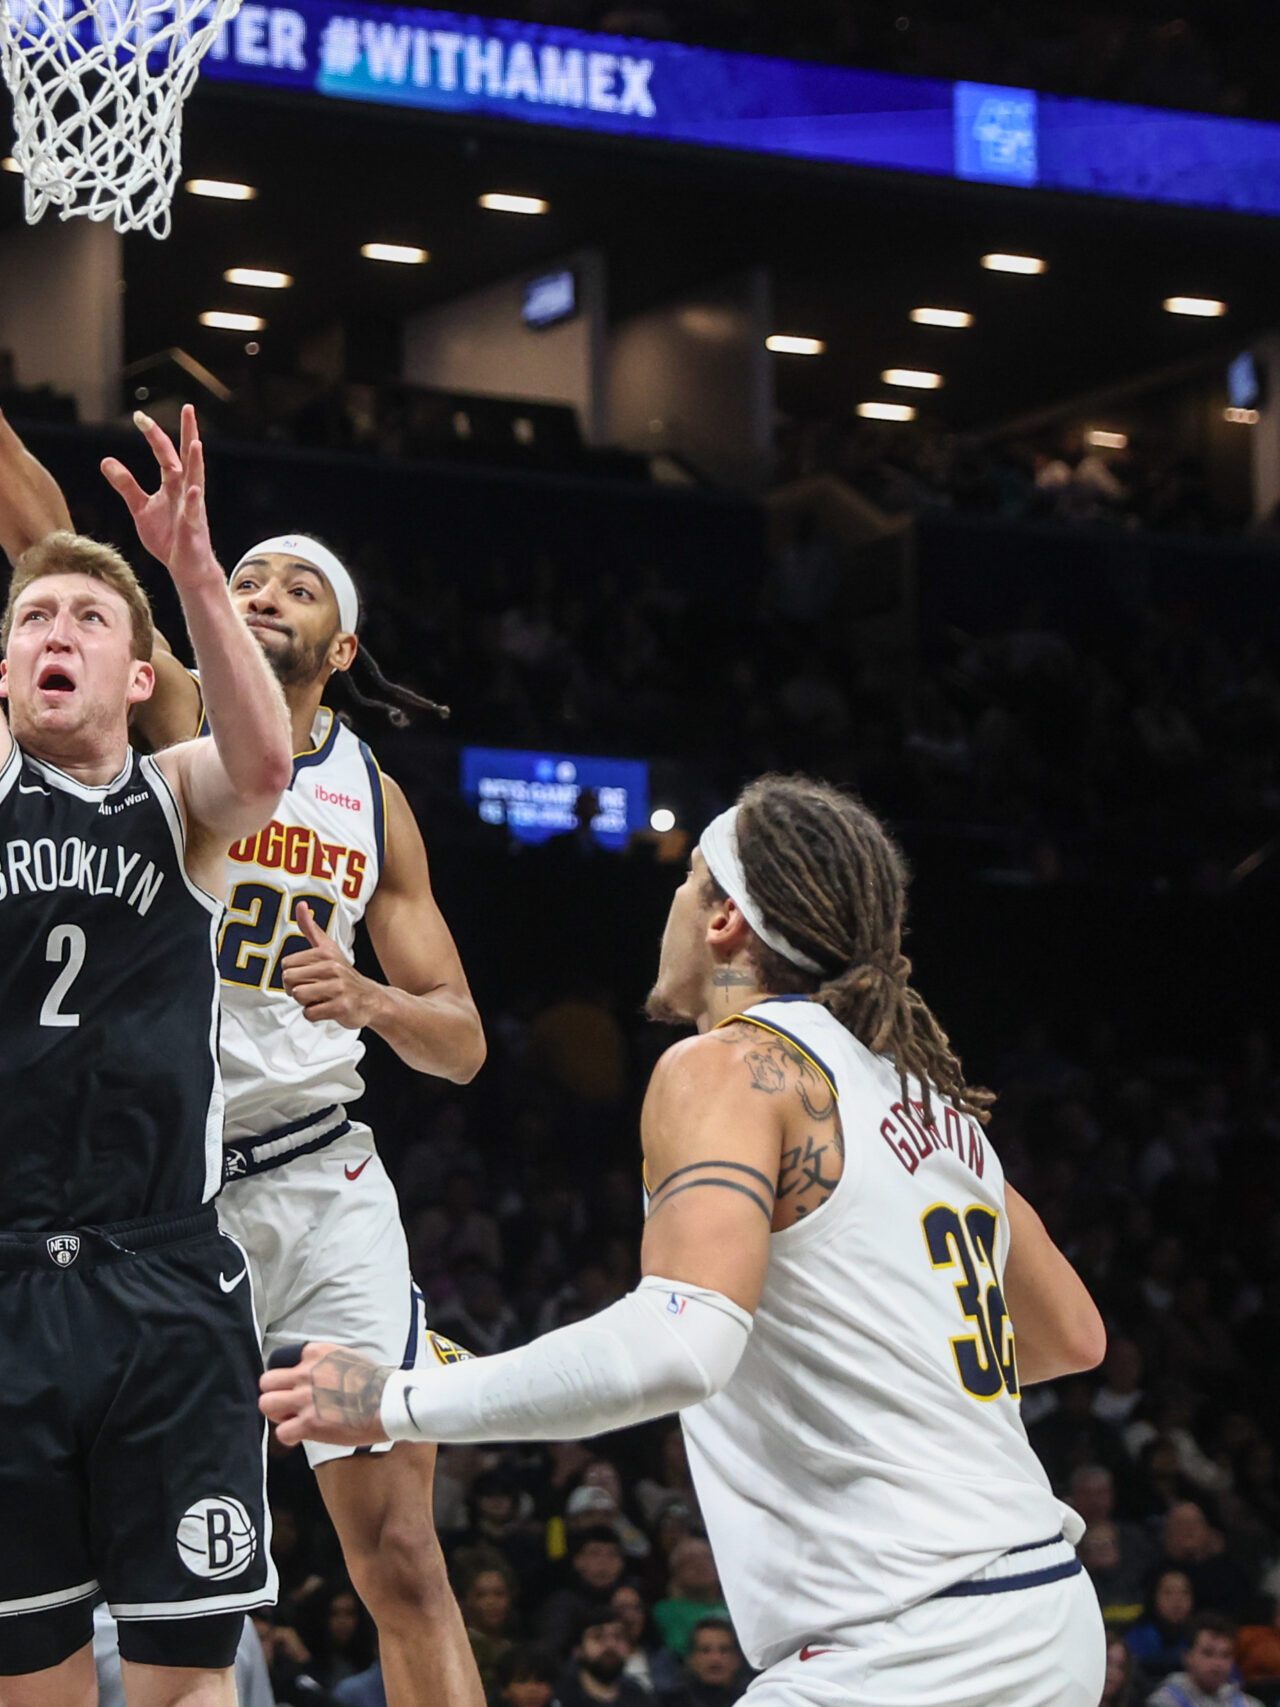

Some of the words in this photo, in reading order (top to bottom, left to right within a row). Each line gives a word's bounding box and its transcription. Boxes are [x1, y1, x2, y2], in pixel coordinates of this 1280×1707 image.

[321, 16, 655, 118] #WITHAMEX
[98, 801, 112, 815] All
[114, 803, 124, 814] In
[124, 791, 149, 807] Won
[315, 784, 361, 812] ibotta
[227, 819, 368, 900] UGGETS
[39, 923, 87, 1027] 2
[50, 1238, 77, 1253] NETS
[920, 1201, 1021, 1402] 32
[206, 1508, 234, 1570] B
